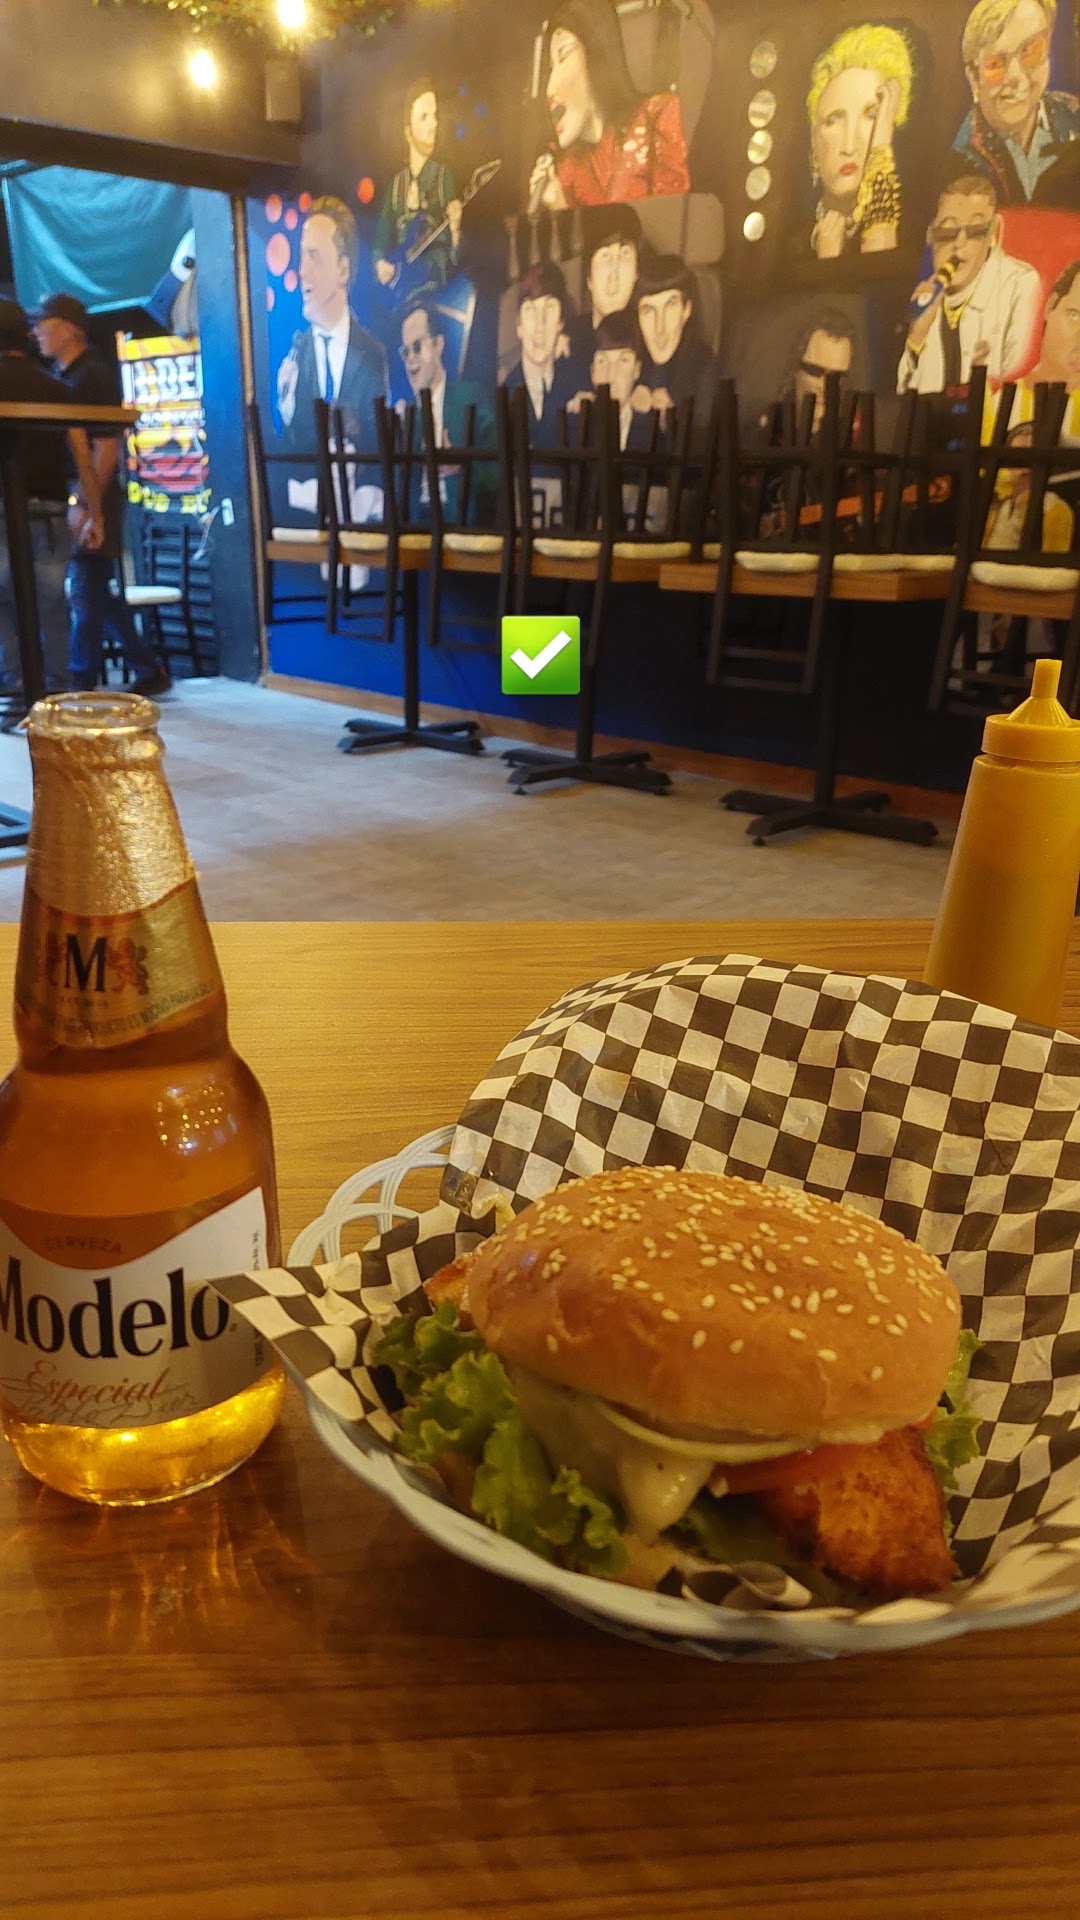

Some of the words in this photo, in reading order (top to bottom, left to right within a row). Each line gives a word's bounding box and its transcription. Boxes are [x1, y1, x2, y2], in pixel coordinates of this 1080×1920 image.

[64, 934, 107, 992] M
[0, 1256, 230, 1359] Modelo
[26, 1360, 170, 1406] Especial
